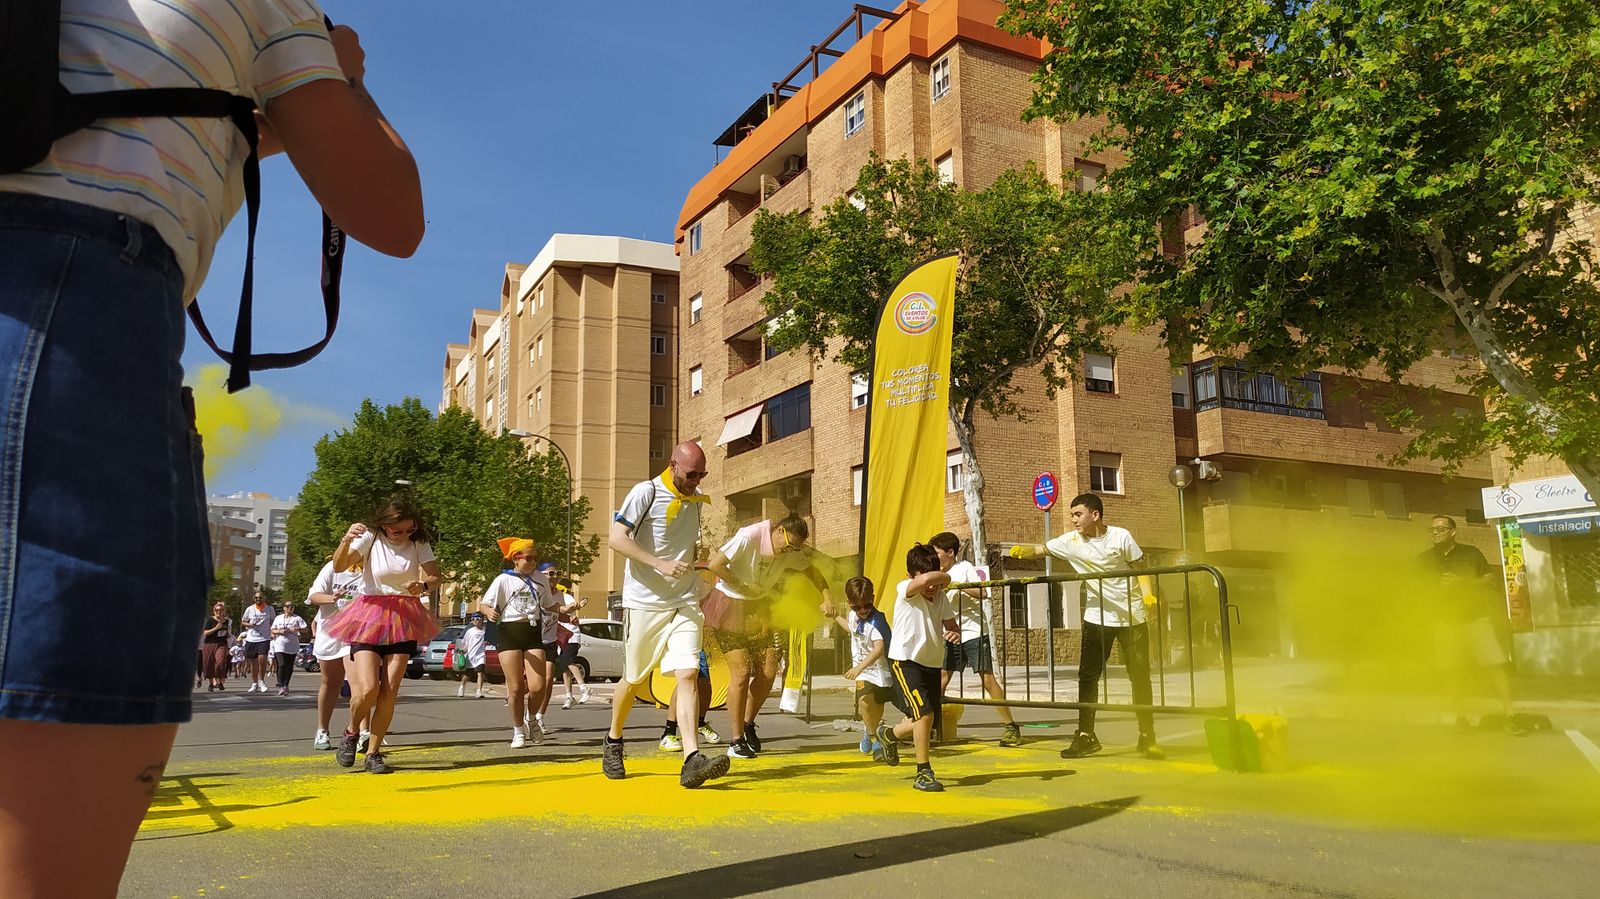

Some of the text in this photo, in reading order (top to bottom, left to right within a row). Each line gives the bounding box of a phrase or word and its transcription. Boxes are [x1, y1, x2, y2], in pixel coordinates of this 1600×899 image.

[892, 364, 928, 377] COLOREA
[880, 380, 895, 389] TUS
[891, 382, 934, 397] MULTIPLICA
[885, 399, 896, 408] TU
[1535, 484, 1577, 499] Electro
[1538, 520, 1600, 534] Instalacio
